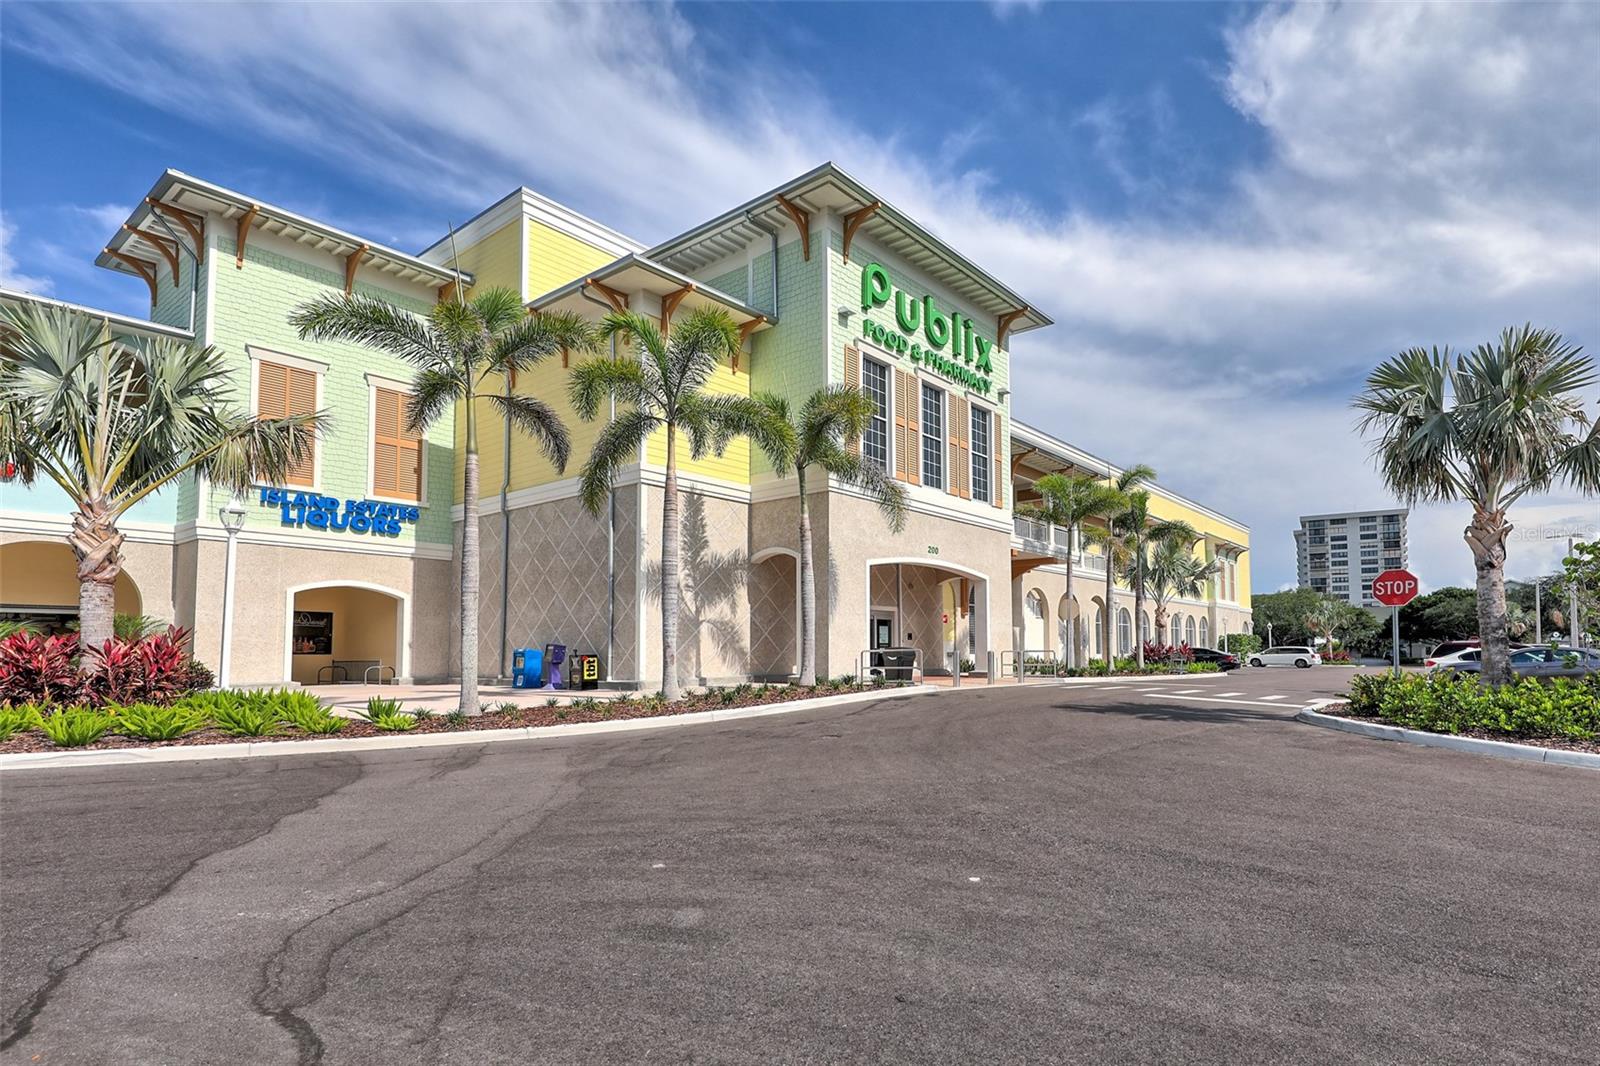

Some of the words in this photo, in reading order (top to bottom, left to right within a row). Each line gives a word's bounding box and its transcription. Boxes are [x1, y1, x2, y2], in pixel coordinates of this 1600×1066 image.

[861, 262, 993, 374] Publix
[863, 319, 909, 353] FOOD
[910, 343, 922, 361] &
[924, 349, 992, 393] PHARMACY
[260, 487, 340, 509] ISLAND
[345, 500, 419, 521] ESTATES
[281, 504, 402, 534] LIQUORS
[928, 545, 939, 555] 200
[1375, 580, 1415, 595] STOP
